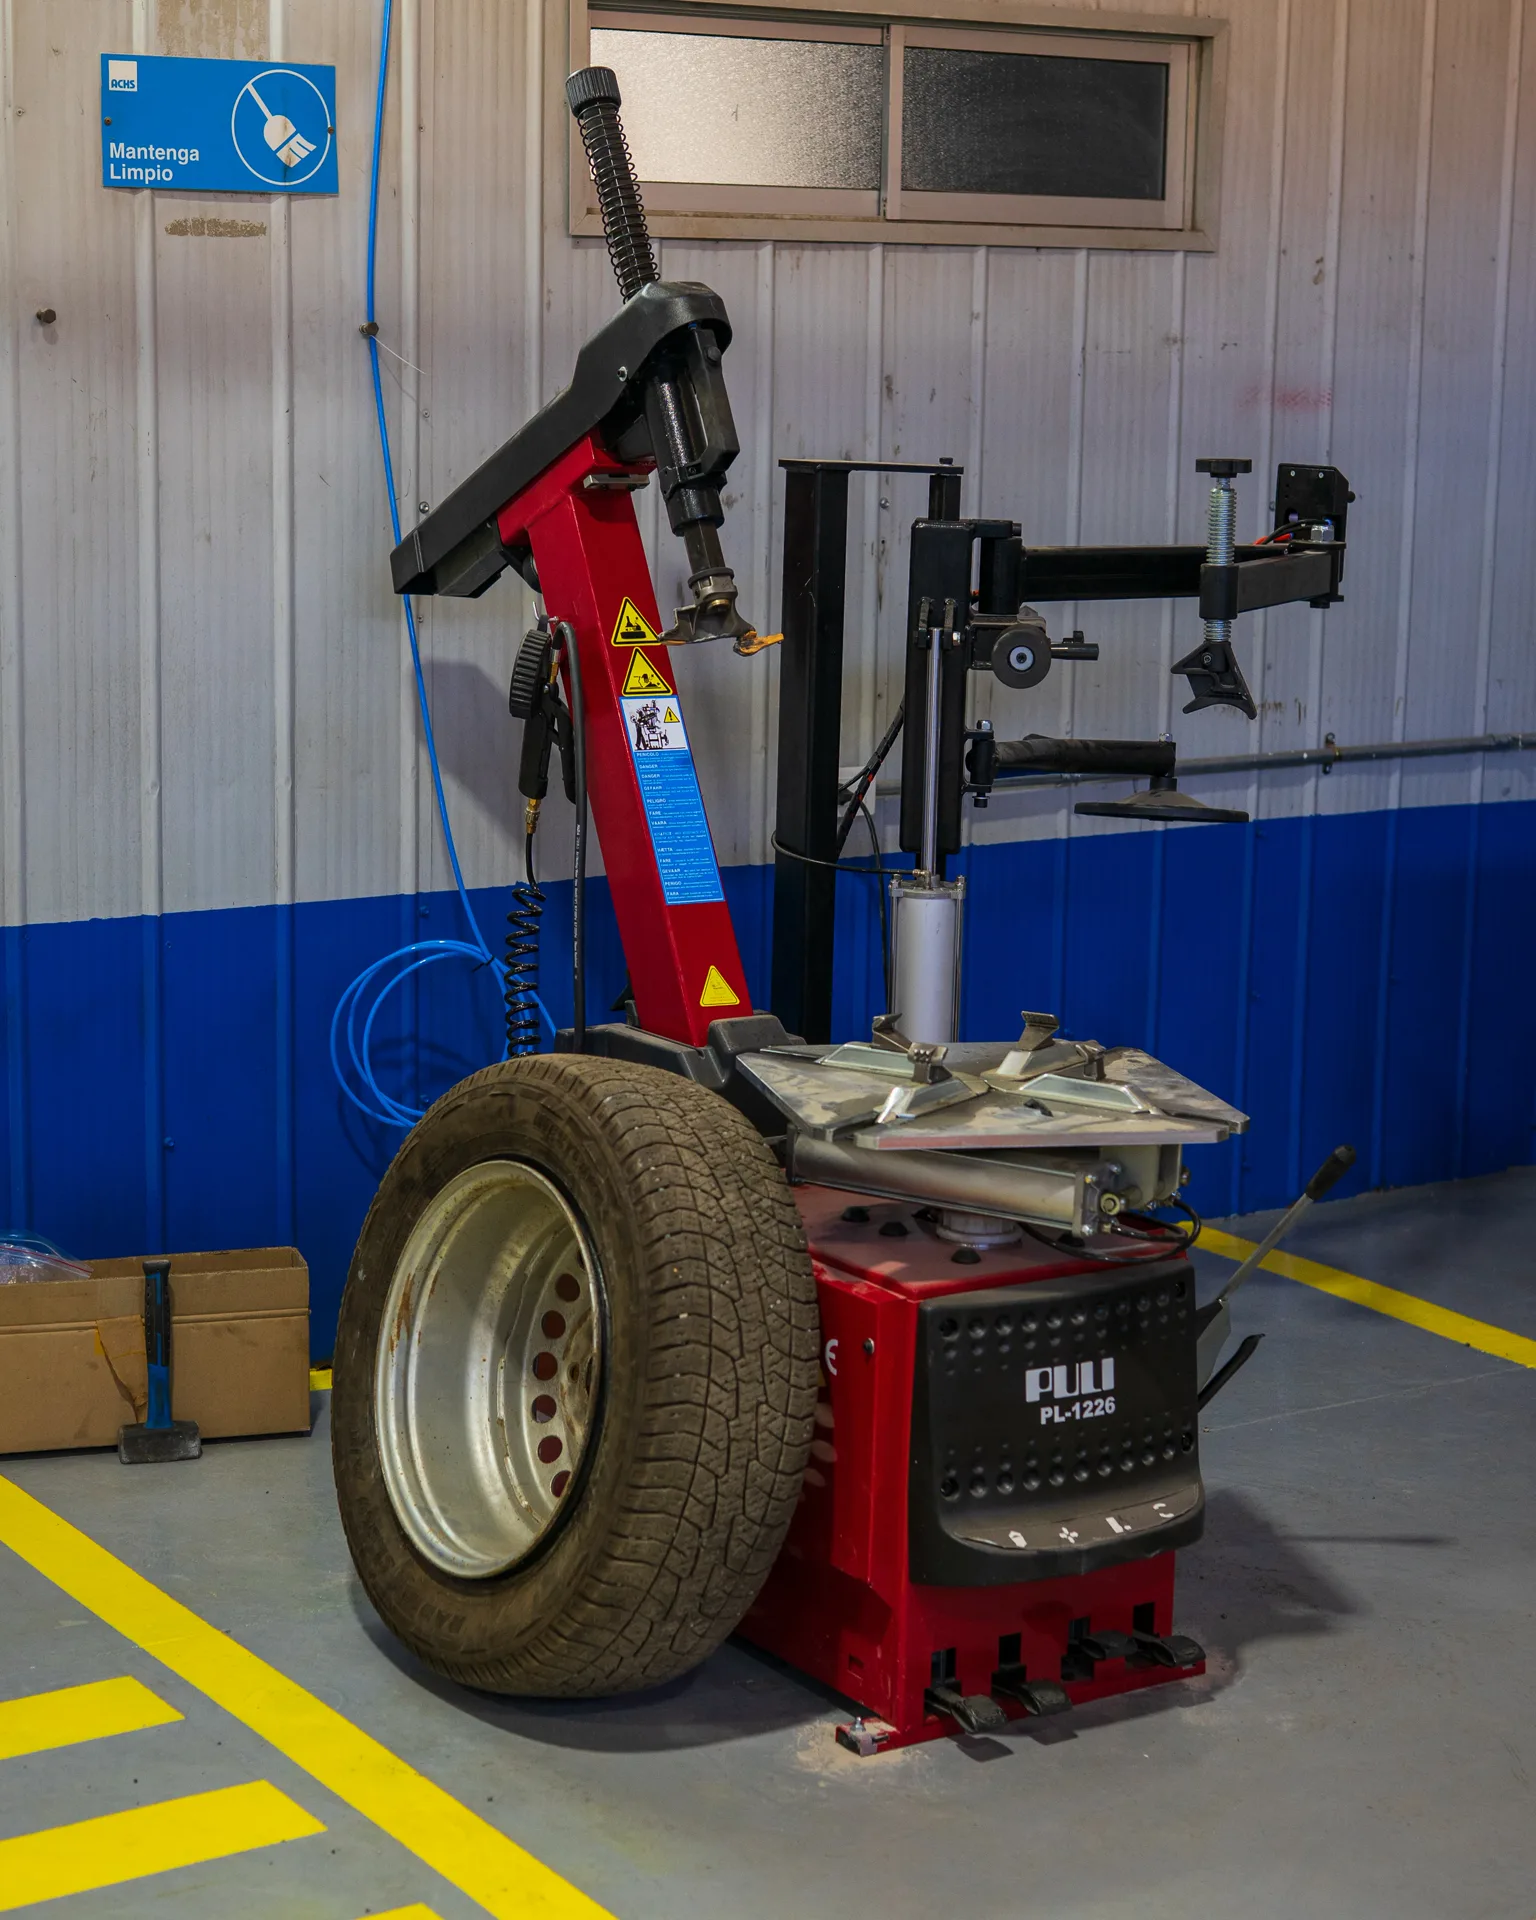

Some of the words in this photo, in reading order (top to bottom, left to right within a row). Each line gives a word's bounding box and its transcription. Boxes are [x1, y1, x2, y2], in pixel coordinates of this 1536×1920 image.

[111, 79, 136, 90] ACHS
[109, 142, 200, 165] Mantenga
[110, 163, 174, 185] Limpio
[1025, 1357, 1115, 1403] PULI
[1040, 1396, 1116, 1425] PL-1226
